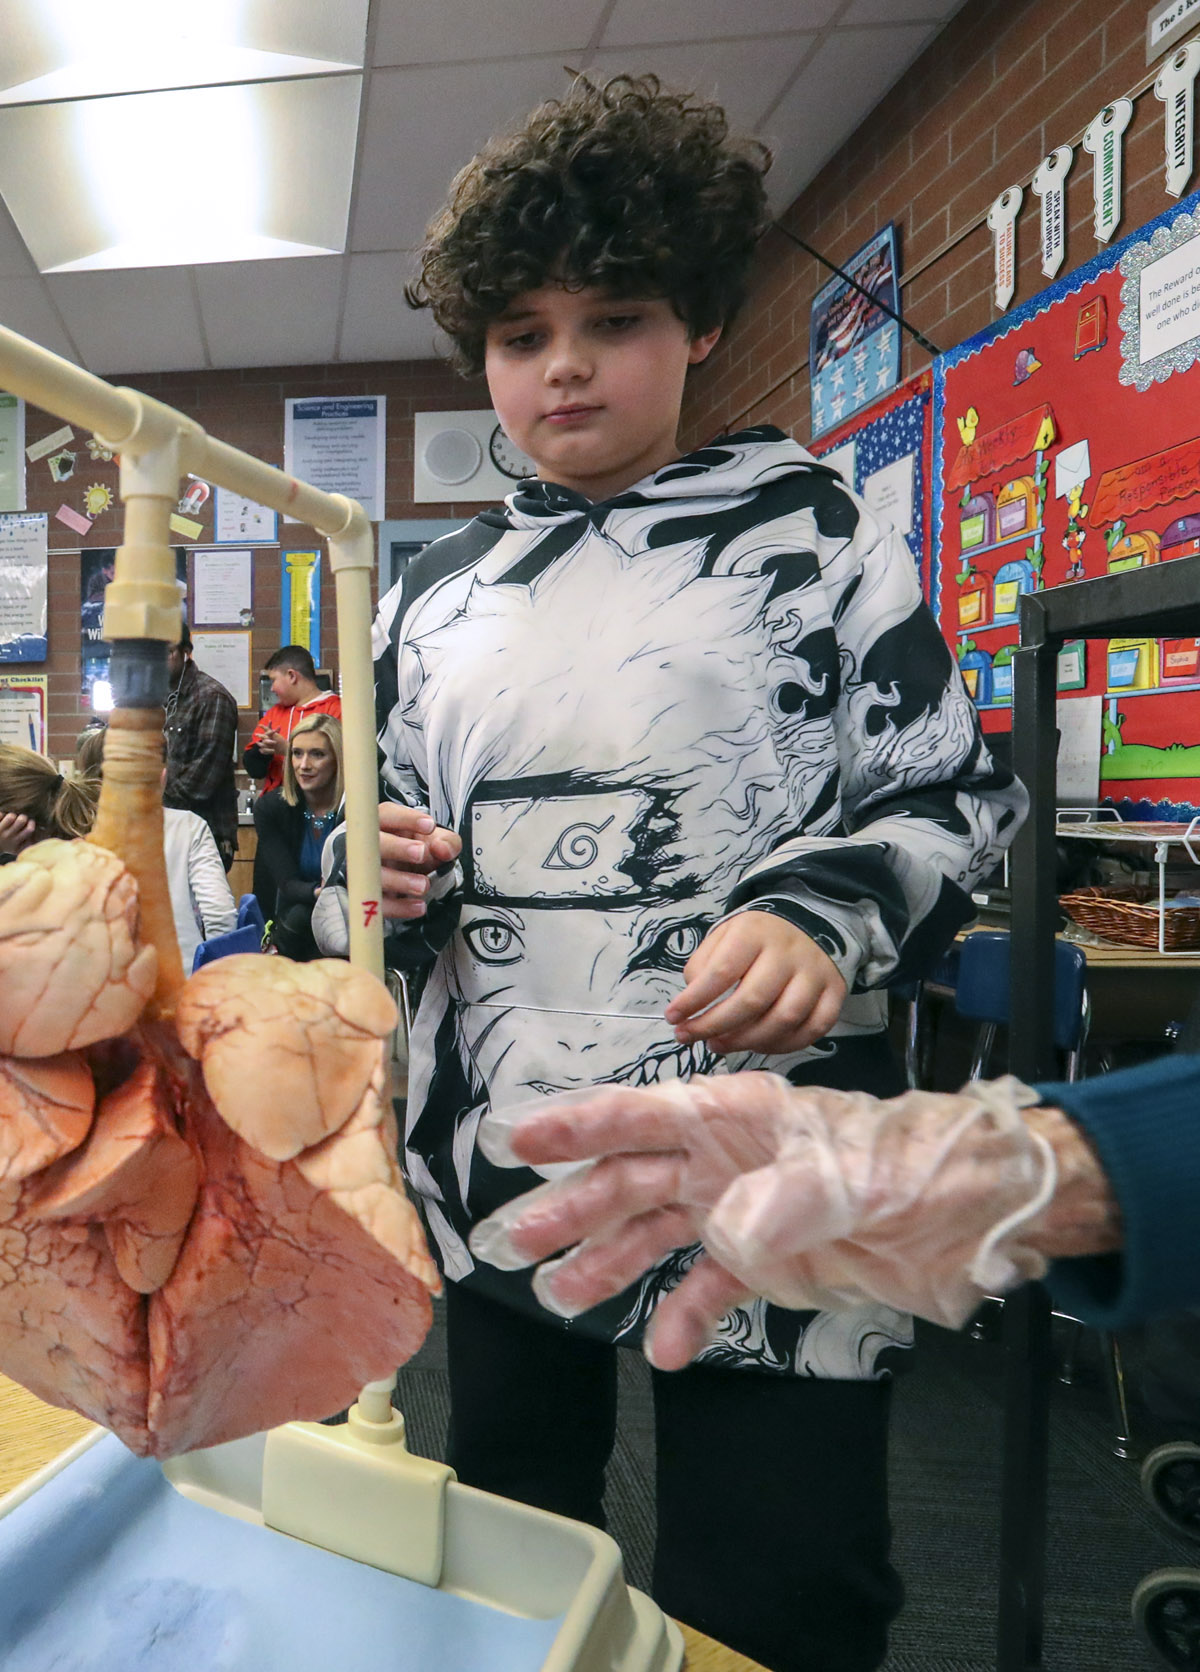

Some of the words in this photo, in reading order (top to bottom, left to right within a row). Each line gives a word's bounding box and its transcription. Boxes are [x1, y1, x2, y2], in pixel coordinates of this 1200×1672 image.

[1159, 14, 1176, 32] The
[1174, 88, 1186, 170] INTEGRITY
[1102, 130, 1114, 227] COMMITMENT
[1045, 190, 1053, 217] GOOD
[1053, 190, 1061, 222] SPEAK
[999, 232, 1005, 246] TO
[1045, 217, 1053, 261] PURPOSE
[1053, 222, 1061, 249] WITH
[1148, 288, 1162, 301] The
[1163, 267, 1194, 293] Reward
[1145, 304, 1160, 320] well
[1162, 295, 1181, 311] done
[1183, 290, 1189, 299] is
[1156, 317, 1171, 330] one
[1172, 307, 1190, 321] who
[1136, 463, 1151, 475] am
[1120, 465, 1189, 501] Responsible
[1170, 655, 1189, 664] Sophia
[362, 901, 379, 928] 7
